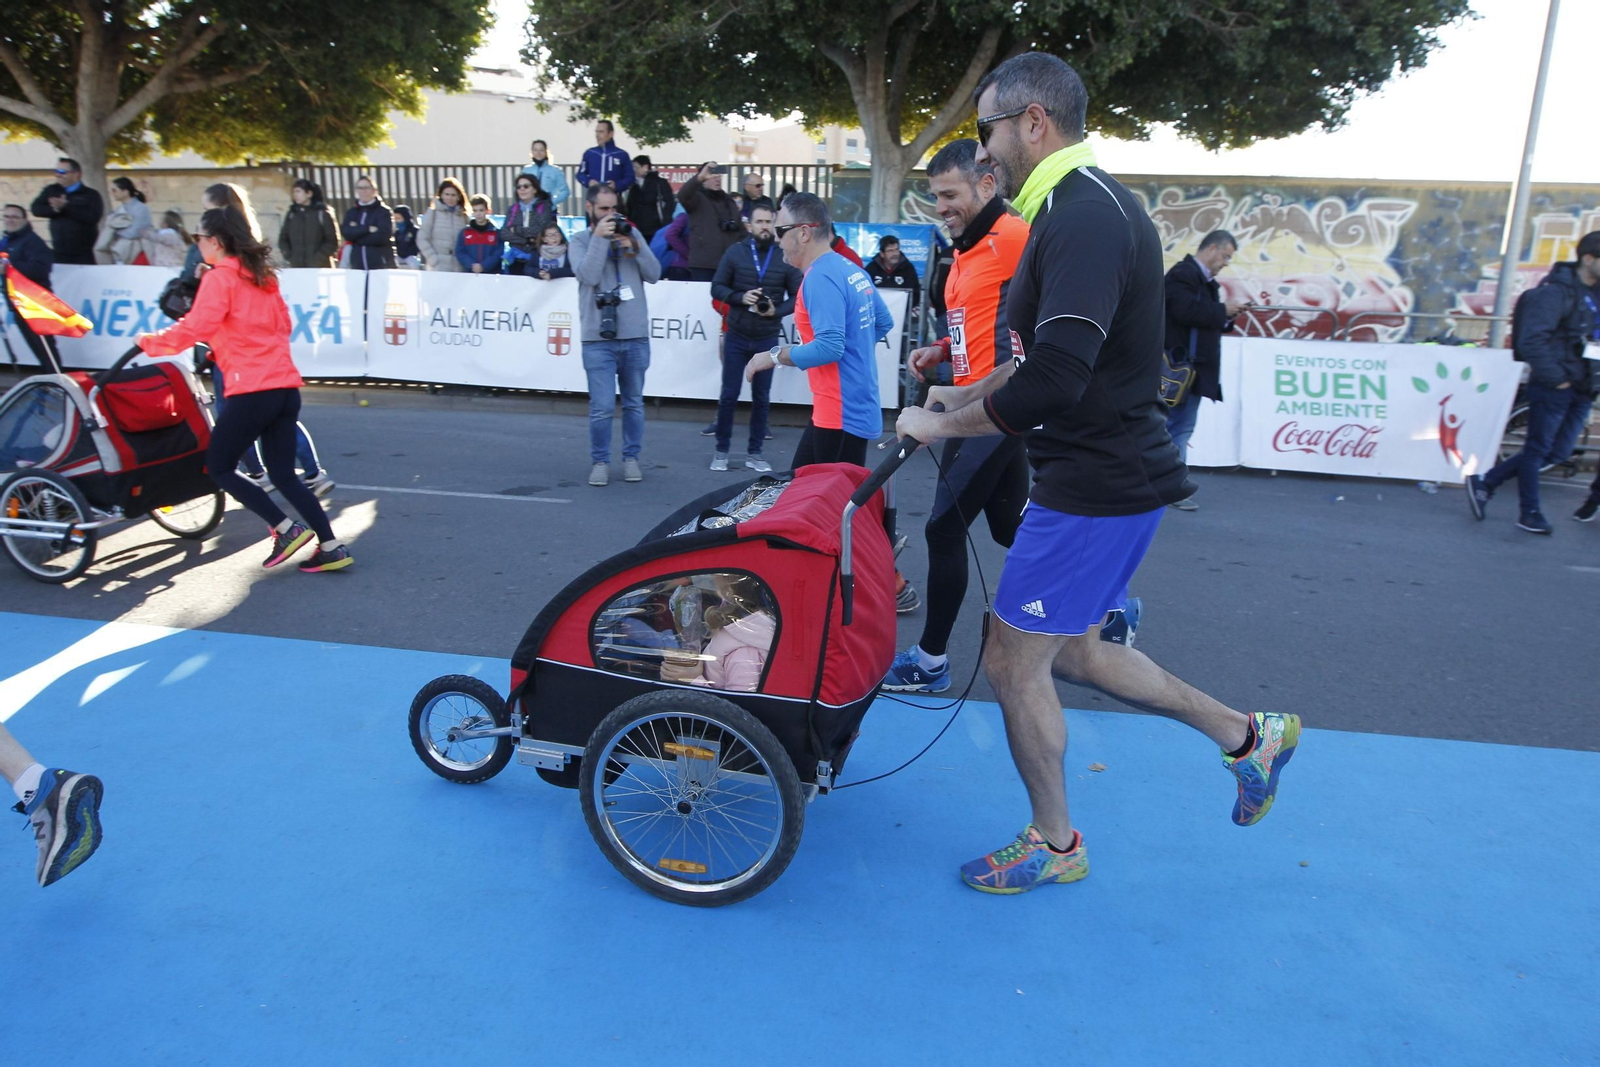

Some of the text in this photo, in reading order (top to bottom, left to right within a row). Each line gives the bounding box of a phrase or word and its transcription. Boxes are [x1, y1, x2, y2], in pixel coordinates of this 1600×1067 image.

[81, 298, 175, 338] NEX
[430, 307, 535, 333] ALMERÍA
[650, 314, 707, 341] ERÍA
[429, 331, 483, 347] CIUDAD
[1275, 354, 1387, 370] EVENTOS CON
[1274, 369, 1388, 401] BUEN
[1275, 400, 1388, 419] AMBIENTE
[1021, 605, 1047, 619] adidas
